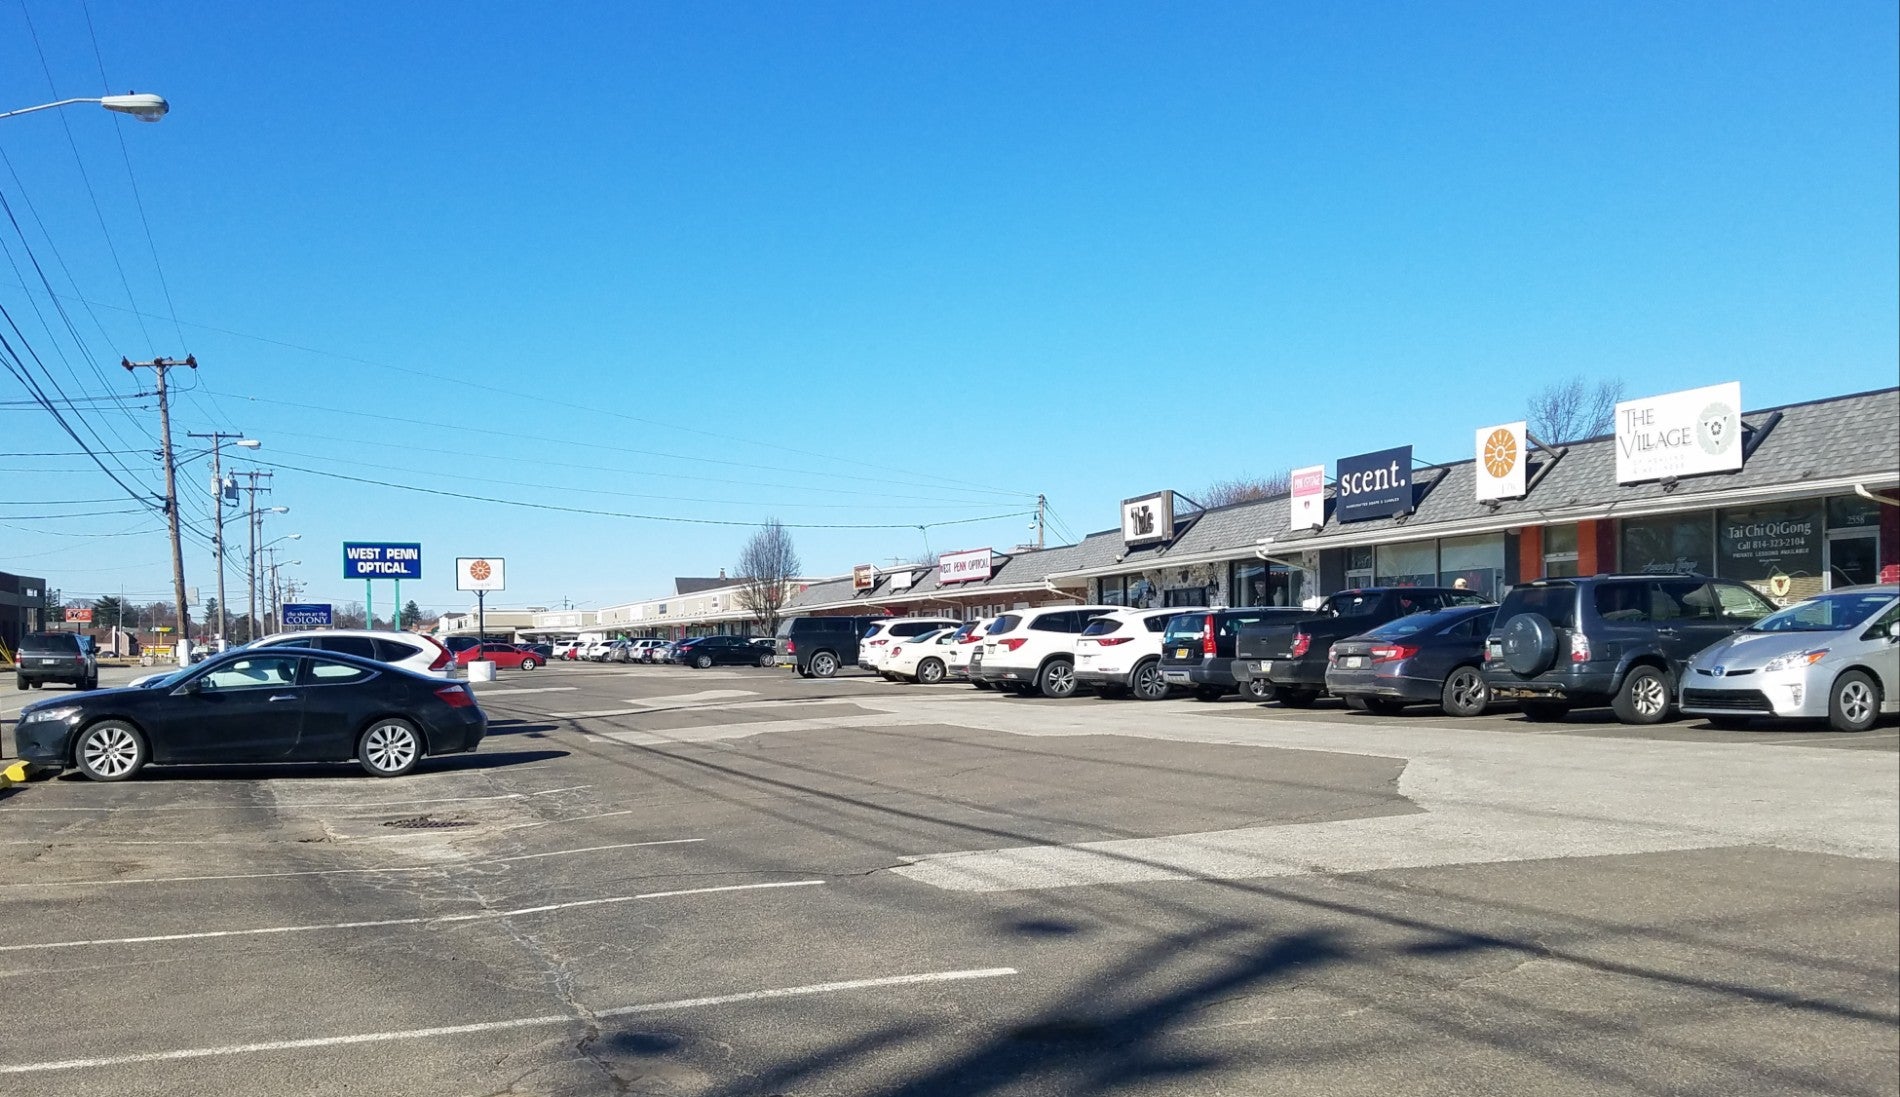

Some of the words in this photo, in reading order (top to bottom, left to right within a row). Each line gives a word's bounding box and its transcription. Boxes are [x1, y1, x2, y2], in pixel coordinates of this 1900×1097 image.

[1621, 408, 1655, 434] THE
[1619, 427, 1692, 459] VILLAGE
[1341, 460, 1406, 496] scent.
[1728, 526, 1743, 538] Tai
[1746, 524, 1764, 537] Chi
[1766, 521, 1811, 538] QiGong
[1738, 541, 1751, 550] Call
[1753, 537, 1805, 549] 814-323-2104
[347, 548, 380, 560] WEST
[386, 548, 418, 560] PENN
[357, 562, 408, 573] OPTICAL
[953, 561, 967, 572] PENN
[968, 557, 989, 570] OPTICAL
[286, 616, 328, 624] COLONY
